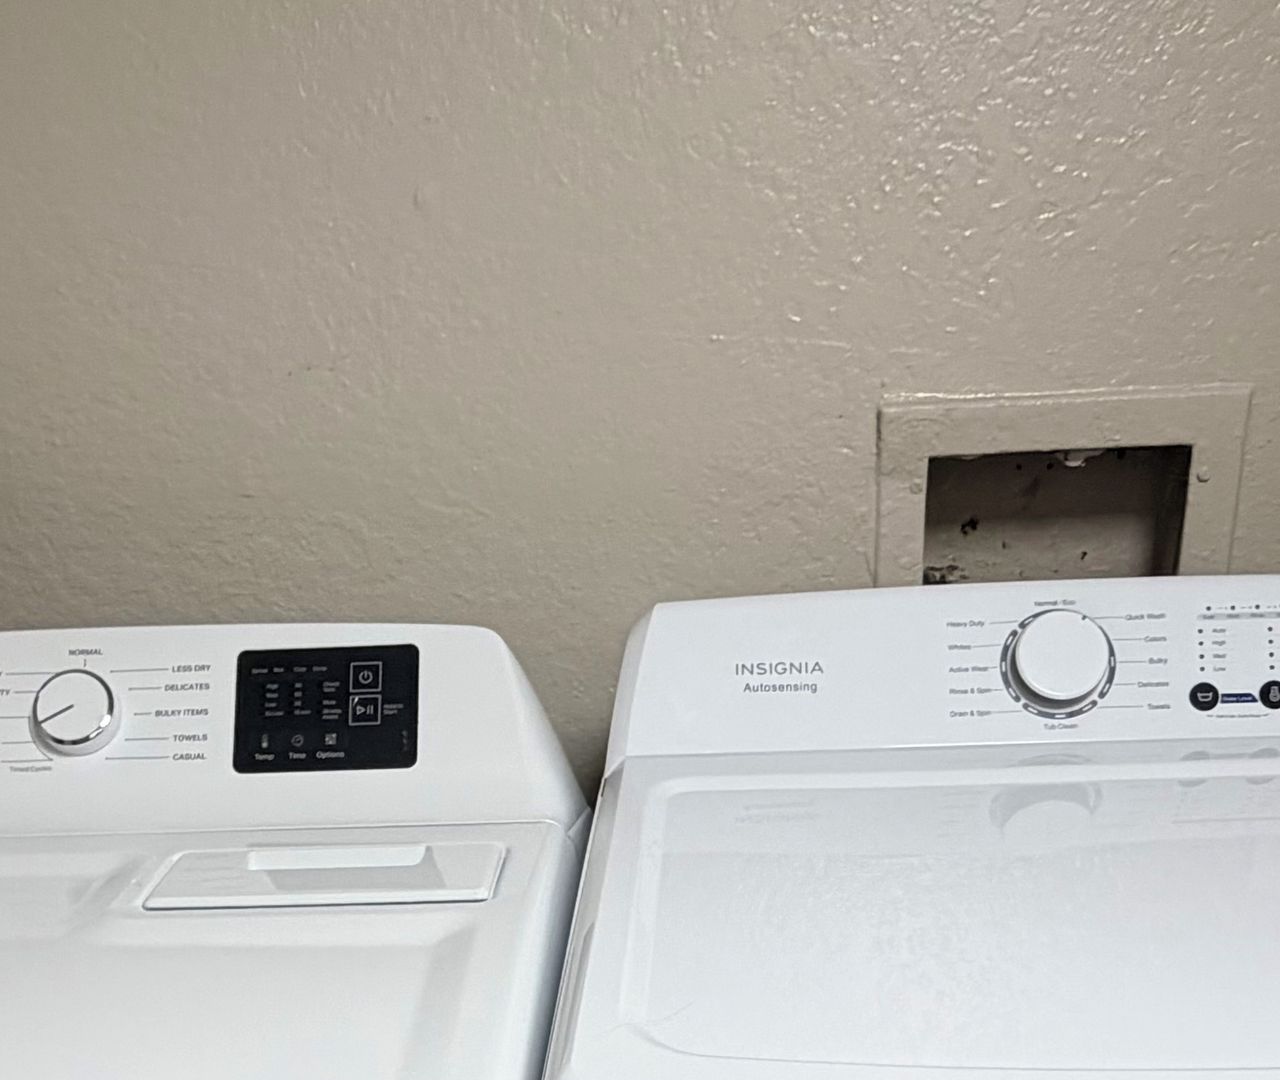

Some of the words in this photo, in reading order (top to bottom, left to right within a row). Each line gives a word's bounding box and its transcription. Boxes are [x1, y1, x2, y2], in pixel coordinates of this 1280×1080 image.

[68, 648, 104, 656] NORMAL
[172, 665, 193, 673] LESS
[194, 664, 211, 672] DRY
[735, 661, 824, 676] INSIGNIA
[164, 683, 210, 692] DELICATES
[743, 682, 818, 694] Autosensing
[154, 709, 182, 717] BULKY
[183, 708, 209, 716] ITEMS
[173, 734, 208, 742] TOWELS
[172, 753, 206, 761] CASUAL
[254, 752, 275, 761] Temp
[288, 752, 307, 760] Time
[315, 751, 345, 760] Options
